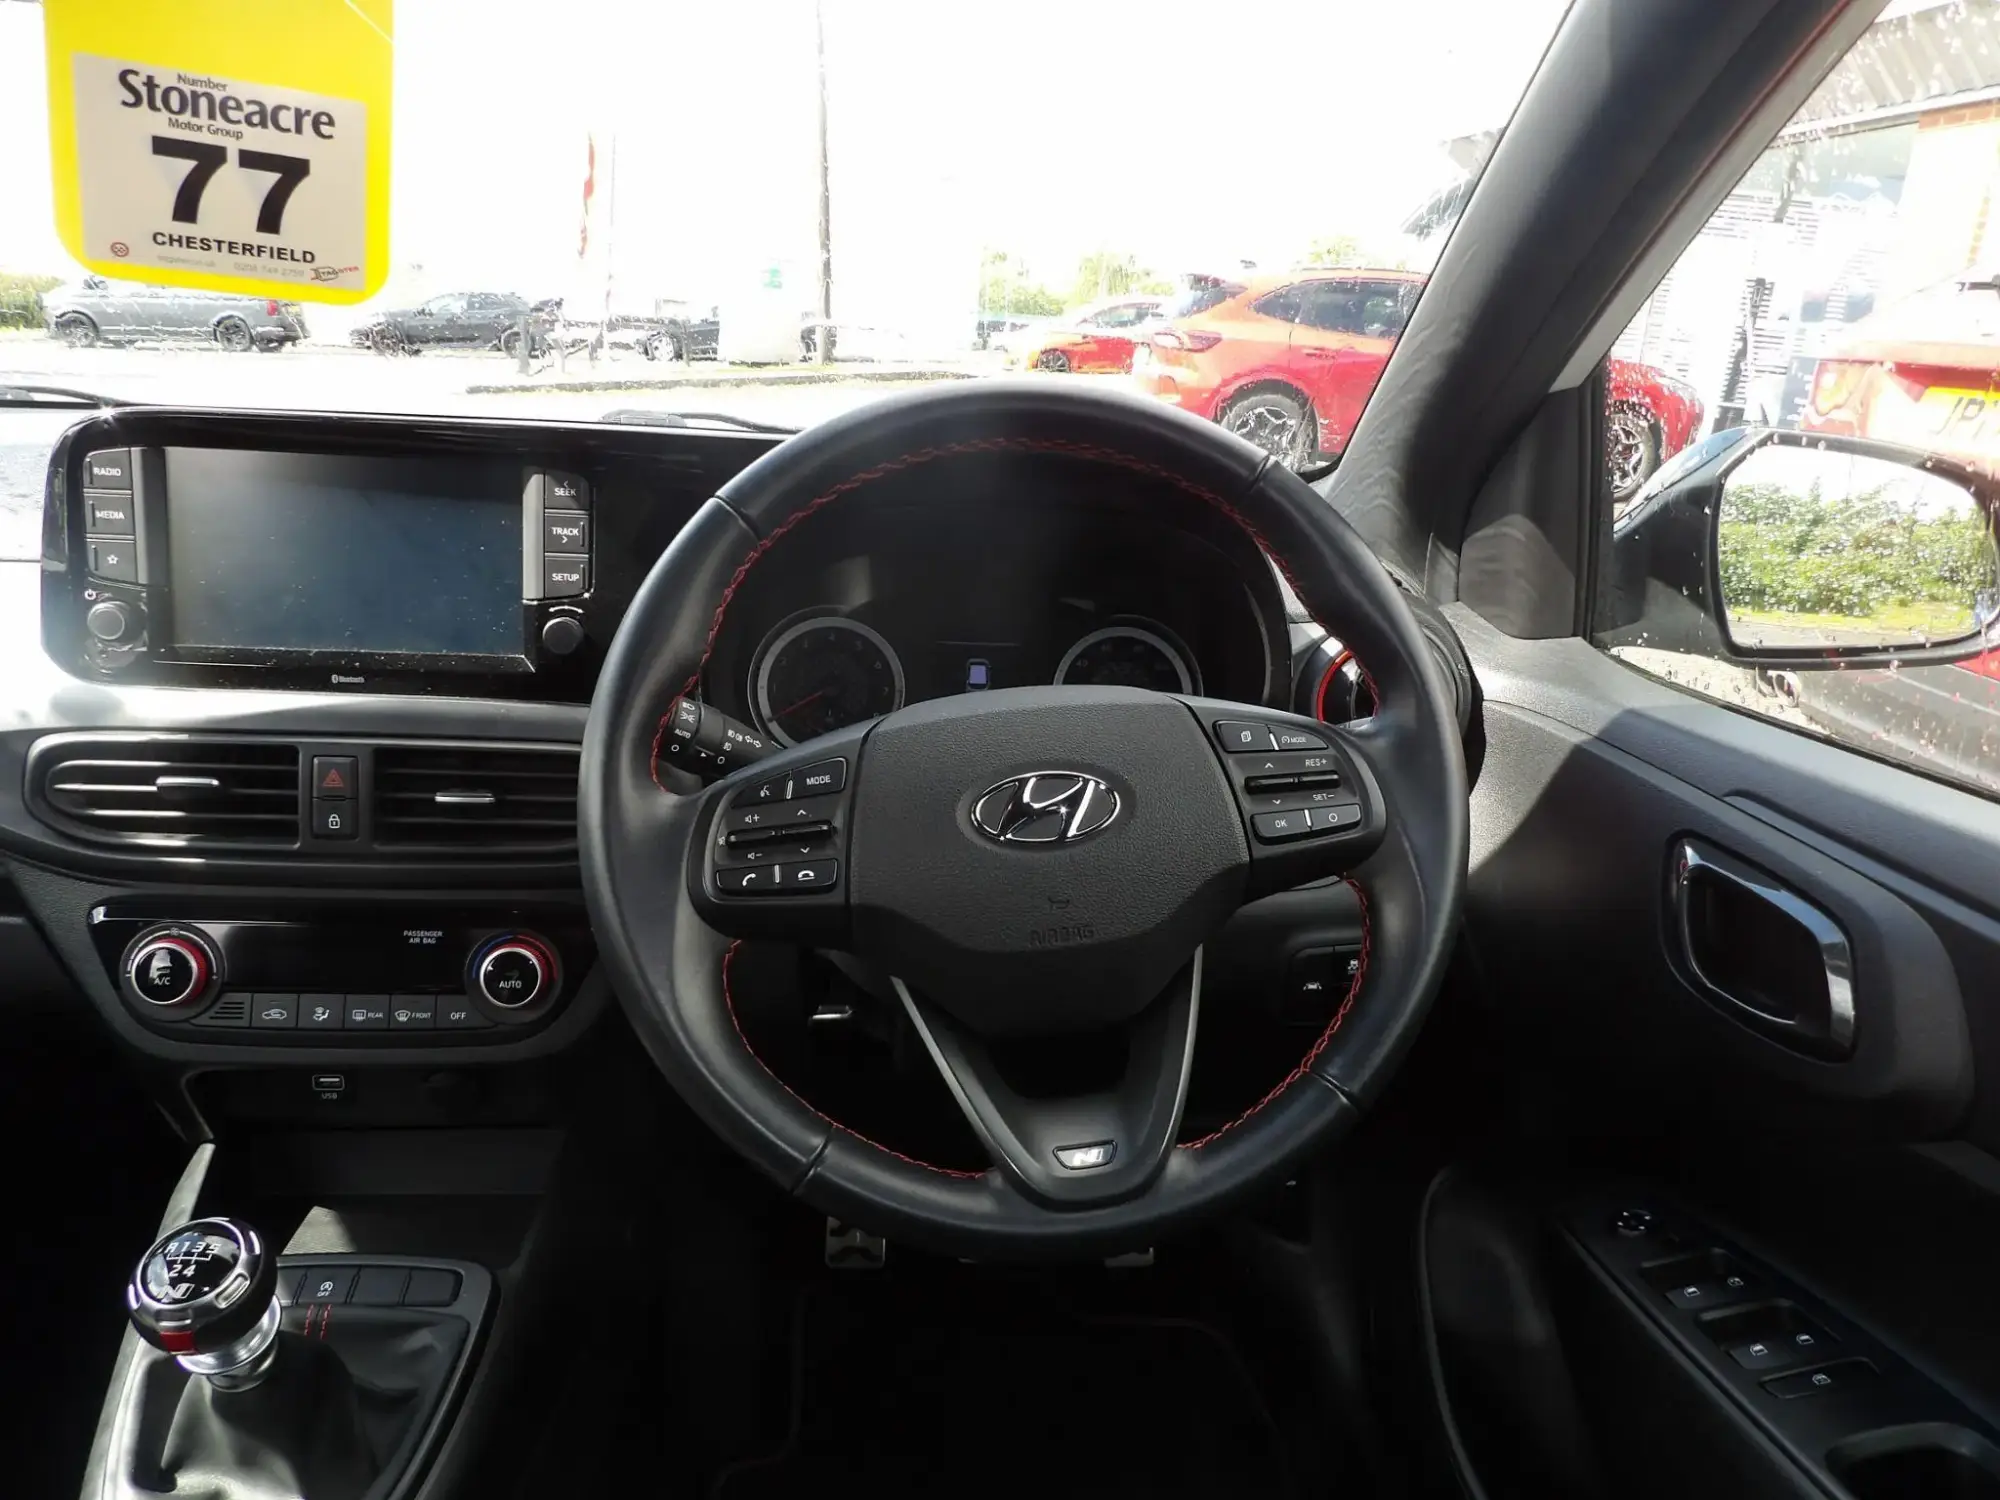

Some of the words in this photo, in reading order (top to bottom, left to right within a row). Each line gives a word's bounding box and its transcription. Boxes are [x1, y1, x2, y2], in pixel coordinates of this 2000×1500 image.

[177, 73, 228, 92] Number
[118, 68, 336, 140] Stoneacre
[168, 117, 203, 134] Motor
[207, 124, 243, 141] Group
[151, 134, 311, 236] 77
[152, 231, 315, 264] CHESTERFIELD
[93, 466, 121, 477] RADIO
[554, 487, 577, 497] SEEK
[95, 510, 125, 520] MEDIA
[551, 526, 579, 536] TRACK
[551, 573, 580, 582] SETUP
[674, 728, 691, 739] AUTO
[806, 774, 831, 786] MODE
[1275, 819, 1288, 828] OK
[403, 929, 444, 939] PASSENGER
[408, 936, 420, 945] AIR
[421, 937, 437, 945] BAG
[153, 976, 171, 987] A/C
[499, 980, 522, 989] AUTO
[367, 1011, 384, 1020] REAR
[411, 1011, 433, 1020] FRONT
[450, 1011, 467, 1021] OFF
[321, 1091, 338, 1100] USB
